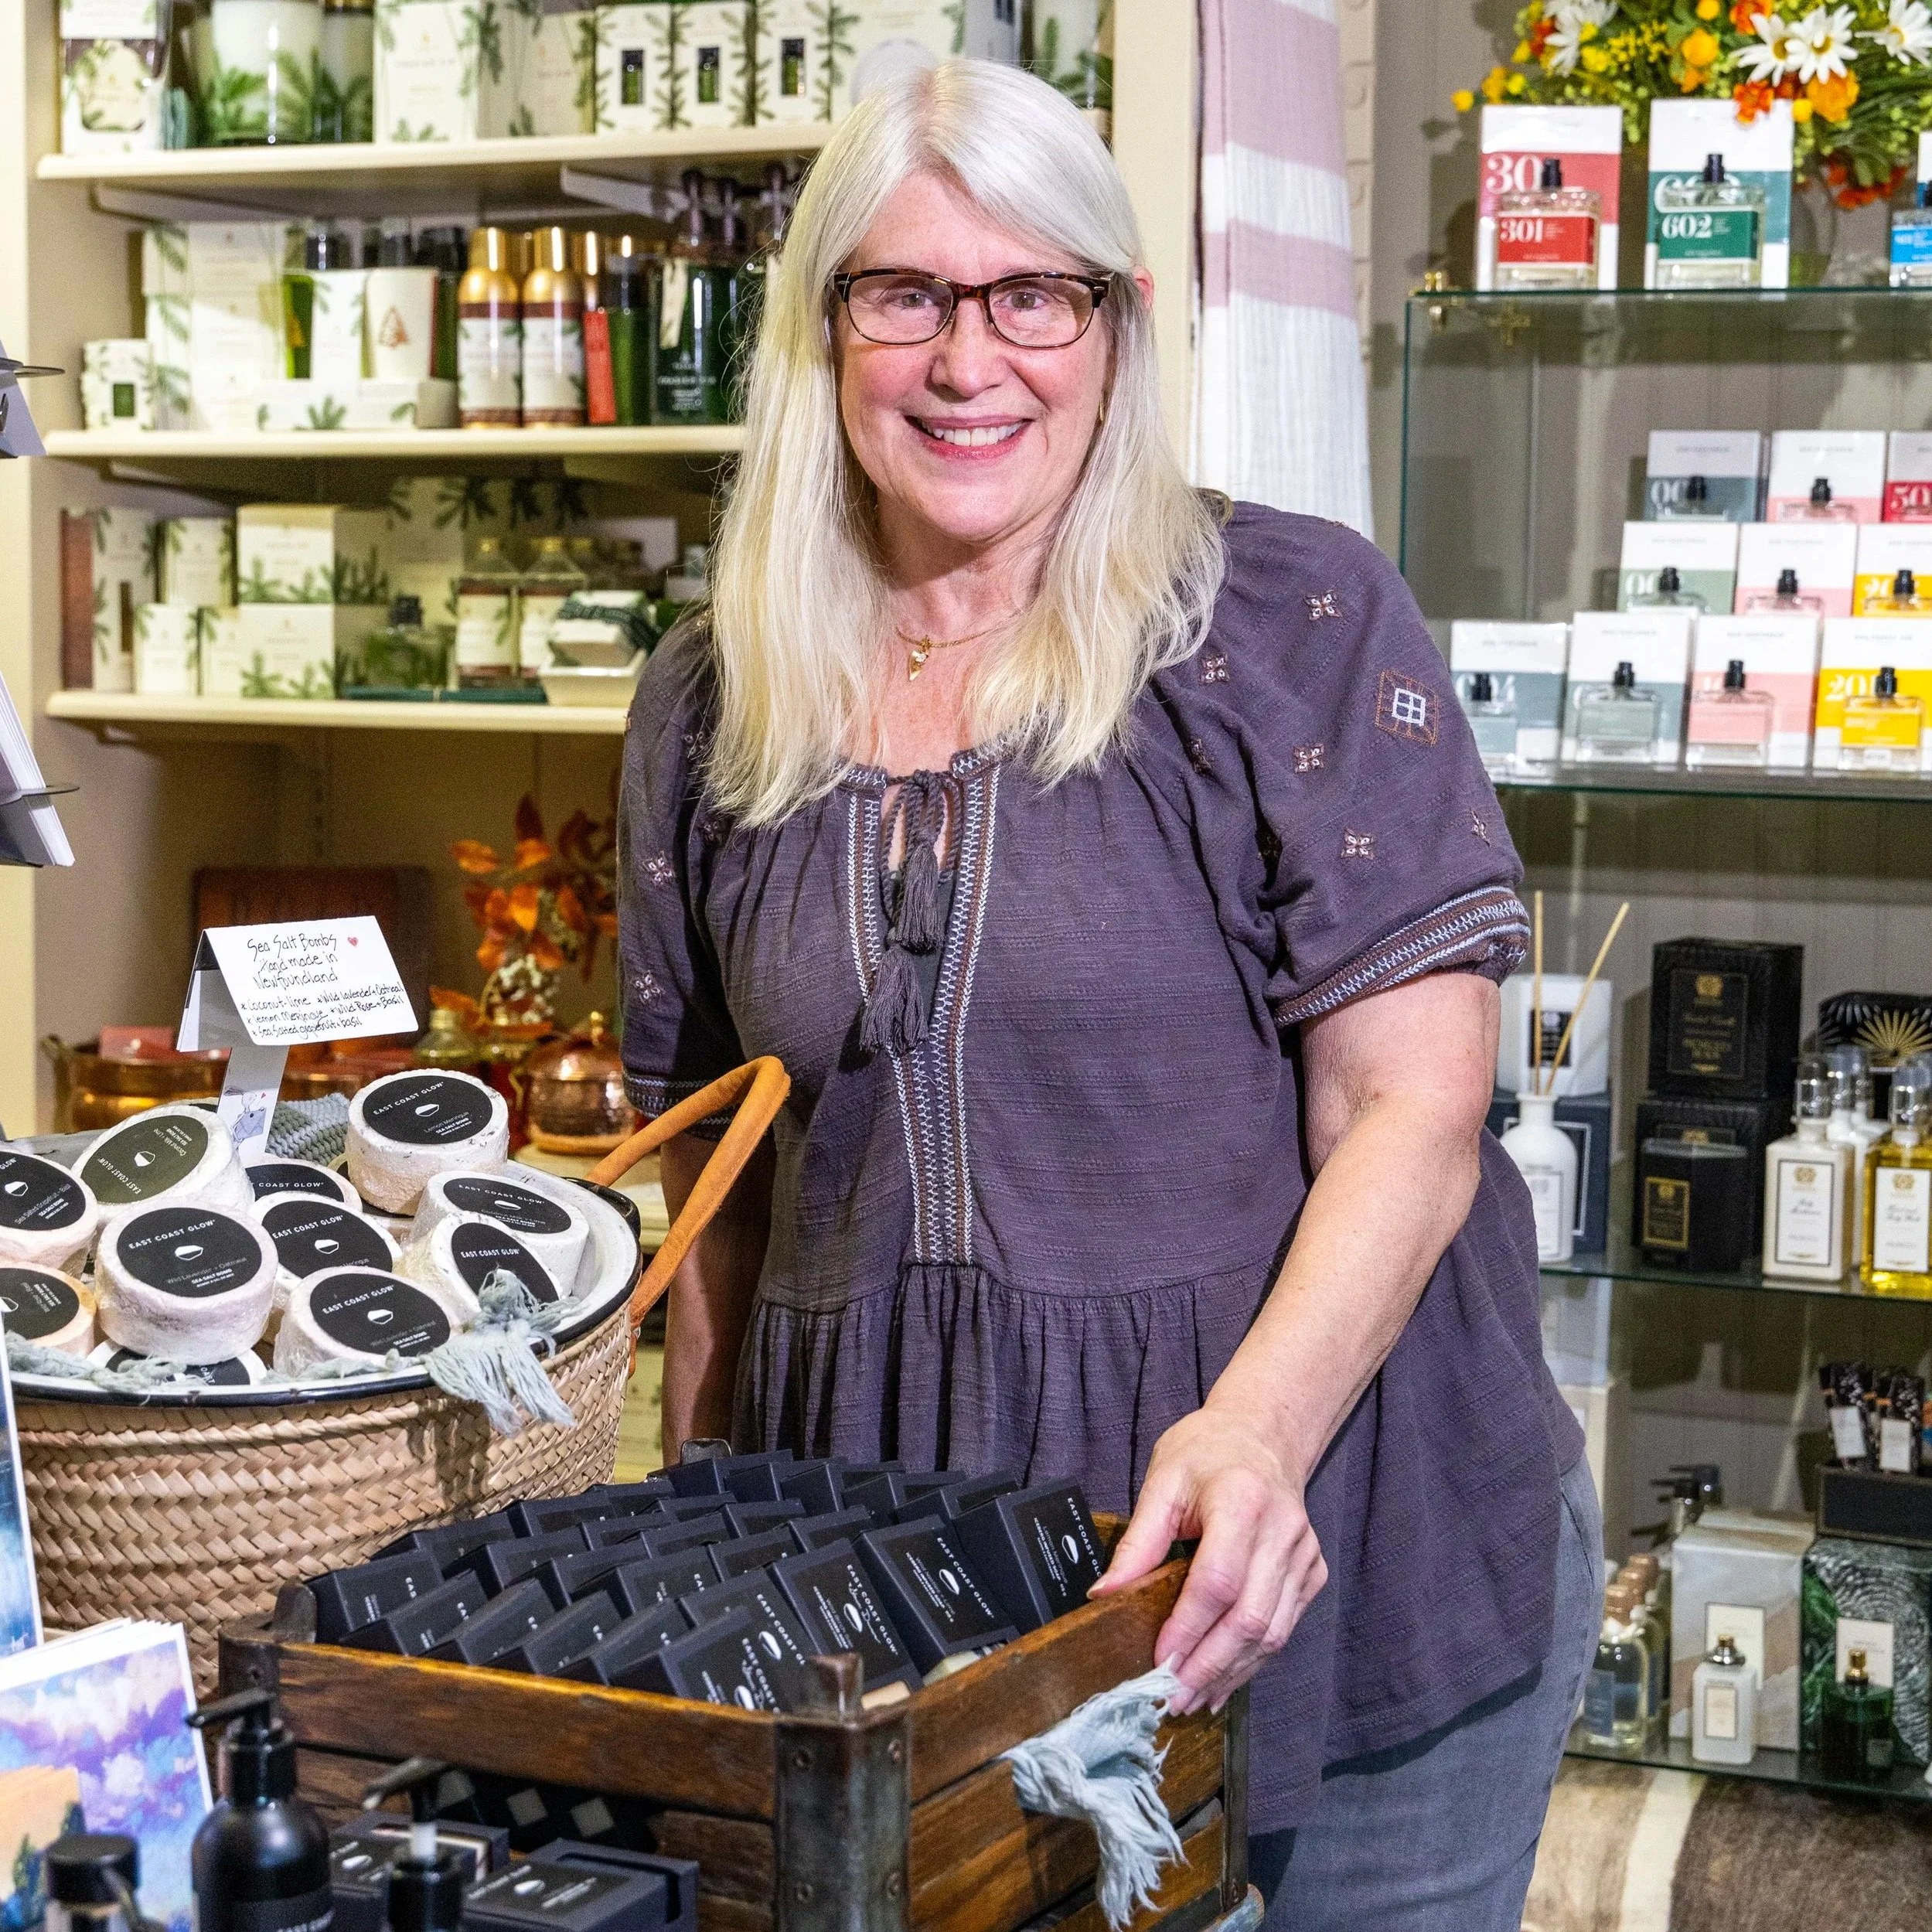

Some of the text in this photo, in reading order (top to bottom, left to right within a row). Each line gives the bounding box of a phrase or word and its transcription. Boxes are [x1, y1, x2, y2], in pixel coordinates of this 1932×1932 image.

[1486, 155, 1544, 193] 30
[1501, 218, 1543, 243] 301
[1662, 213, 1713, 239] 602
[247, 933, 337, 962] Sea Salt Bombs
[288, 954, 323, 966] made
[322, 951, 338, 963] in
[253, 967, 338, 990] Newfoundland
[381, 993, 404, 1009] Basil
[342, 1016, 363, 1028] basil
[373, 1103, 394, 1115] EAST
[394, 1092, 420, 1106] COAST
[111, 1168, 128, 1183] COAST
[126, 1181, 141, 1194] EAST
[485, 1189, 513, 1198] COAST
[128, 1239, 152, 1249] EAST
[155, 1228, 185, 1242] COAST
[272, 1228, 293, 1239] EAST
[294, 1222, 319, 1233] COAST
[461, 1250, 478, 1259] EAST
[479, 1249, 500, 1257] COAST
[322, 1303, 343, 1314] EAST
[344, 1293, 370, 1307] COAST
[1043, 1525, 1055, 1550] Lemon
[1068, 1498, 1102, 1578] EAST COAST GLO
[937, 1537, 954, 1559] EAST
[953, 1561, 974, 1589] COAST
[847, 1564, 863, 1588] EAST
[861, 1591, 881, 1622] COAST
[757, 1593, 775, 1618] EAST
[774, 1620, 797, 1651] COAST
[742, 1637, 758, 1666] EAST
[755, 1668, 776, 1703] COAST
